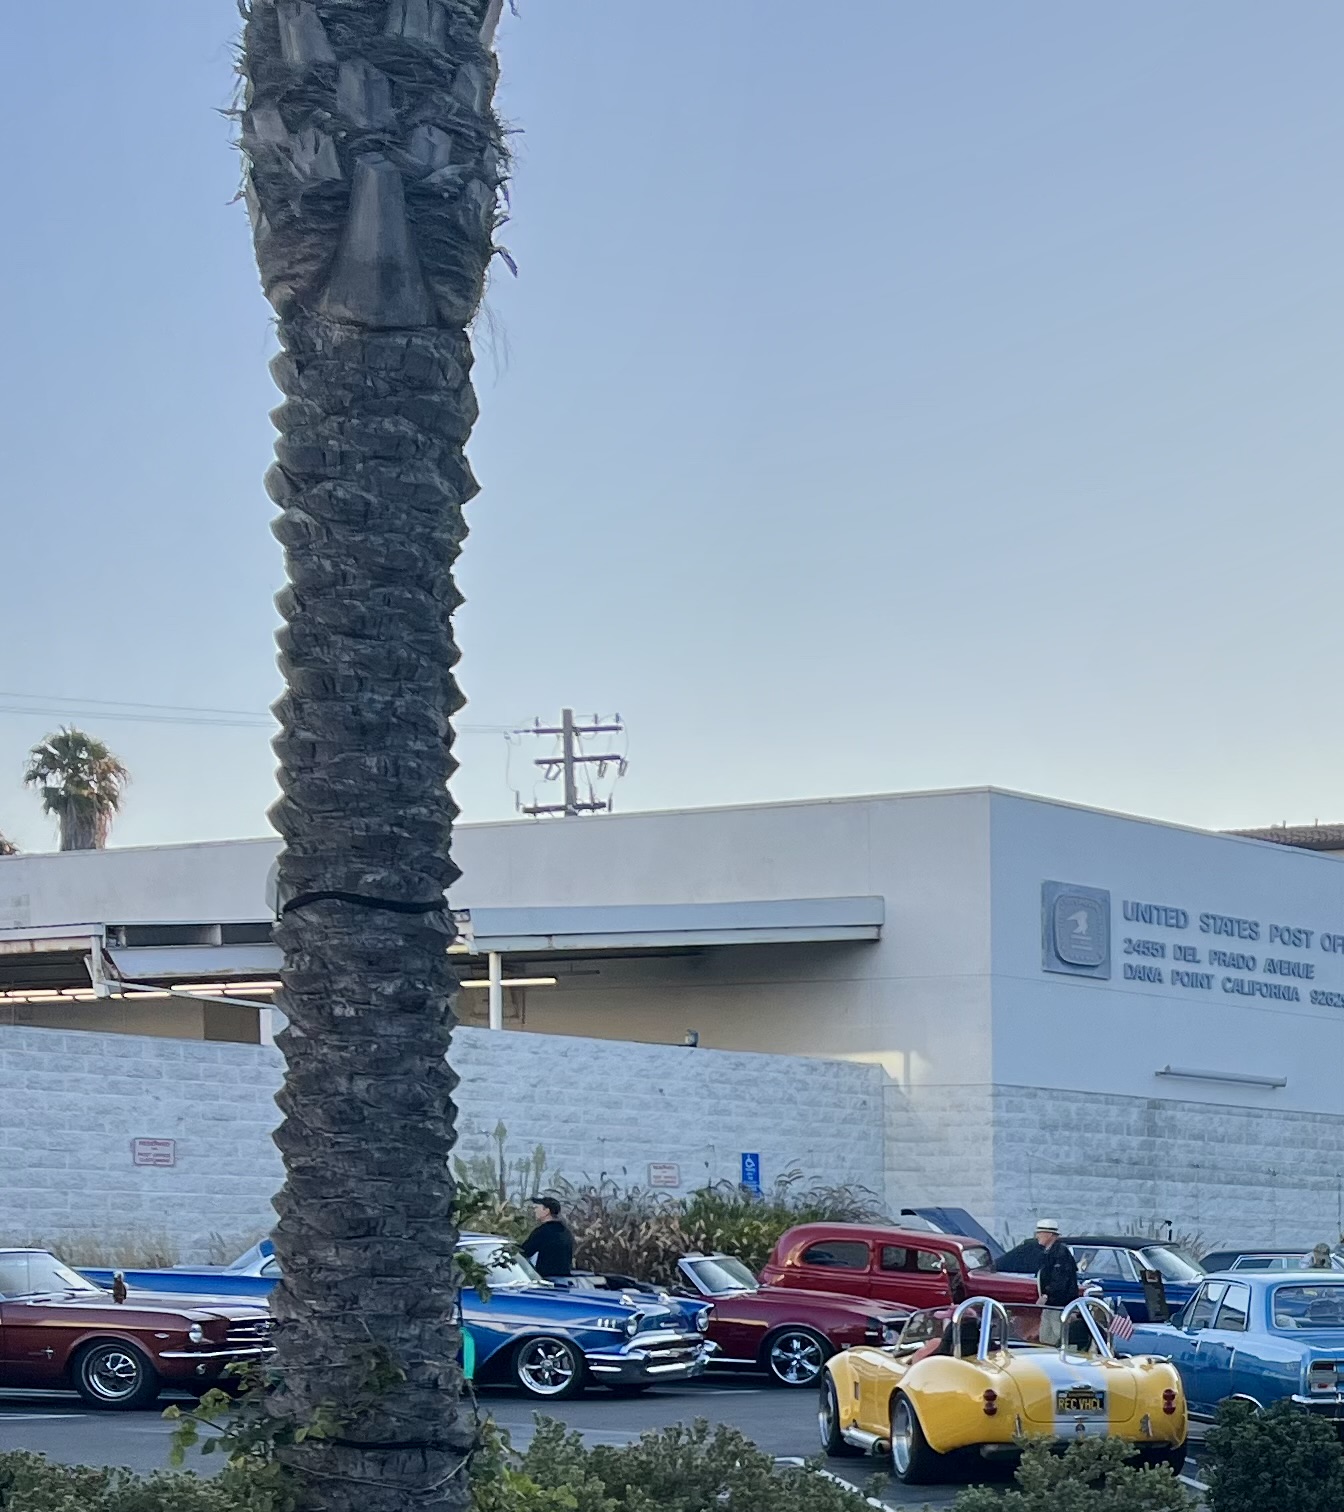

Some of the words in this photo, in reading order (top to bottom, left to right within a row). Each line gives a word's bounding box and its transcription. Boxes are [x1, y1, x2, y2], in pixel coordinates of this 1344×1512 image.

[1122, 900, 1189, 930] UNITED
[1199, 912, 1260, 941] STATES
[1269, 924, 1315, 949] POST
[1123, 938, 1166, 959] 24551
[1173, 944, 1202, 964] DEL
[1209, 949, 1257, 972] PRADO
[1263, 958, 1315, 980] AVENUE
[1123, 963, 1163, 984] DANA
[1171, 969, 1215, 990] POINT
[1222, 975, 1301, 1003] CALIFORNIA
[1058, 1398, 1077, 1410] REC
